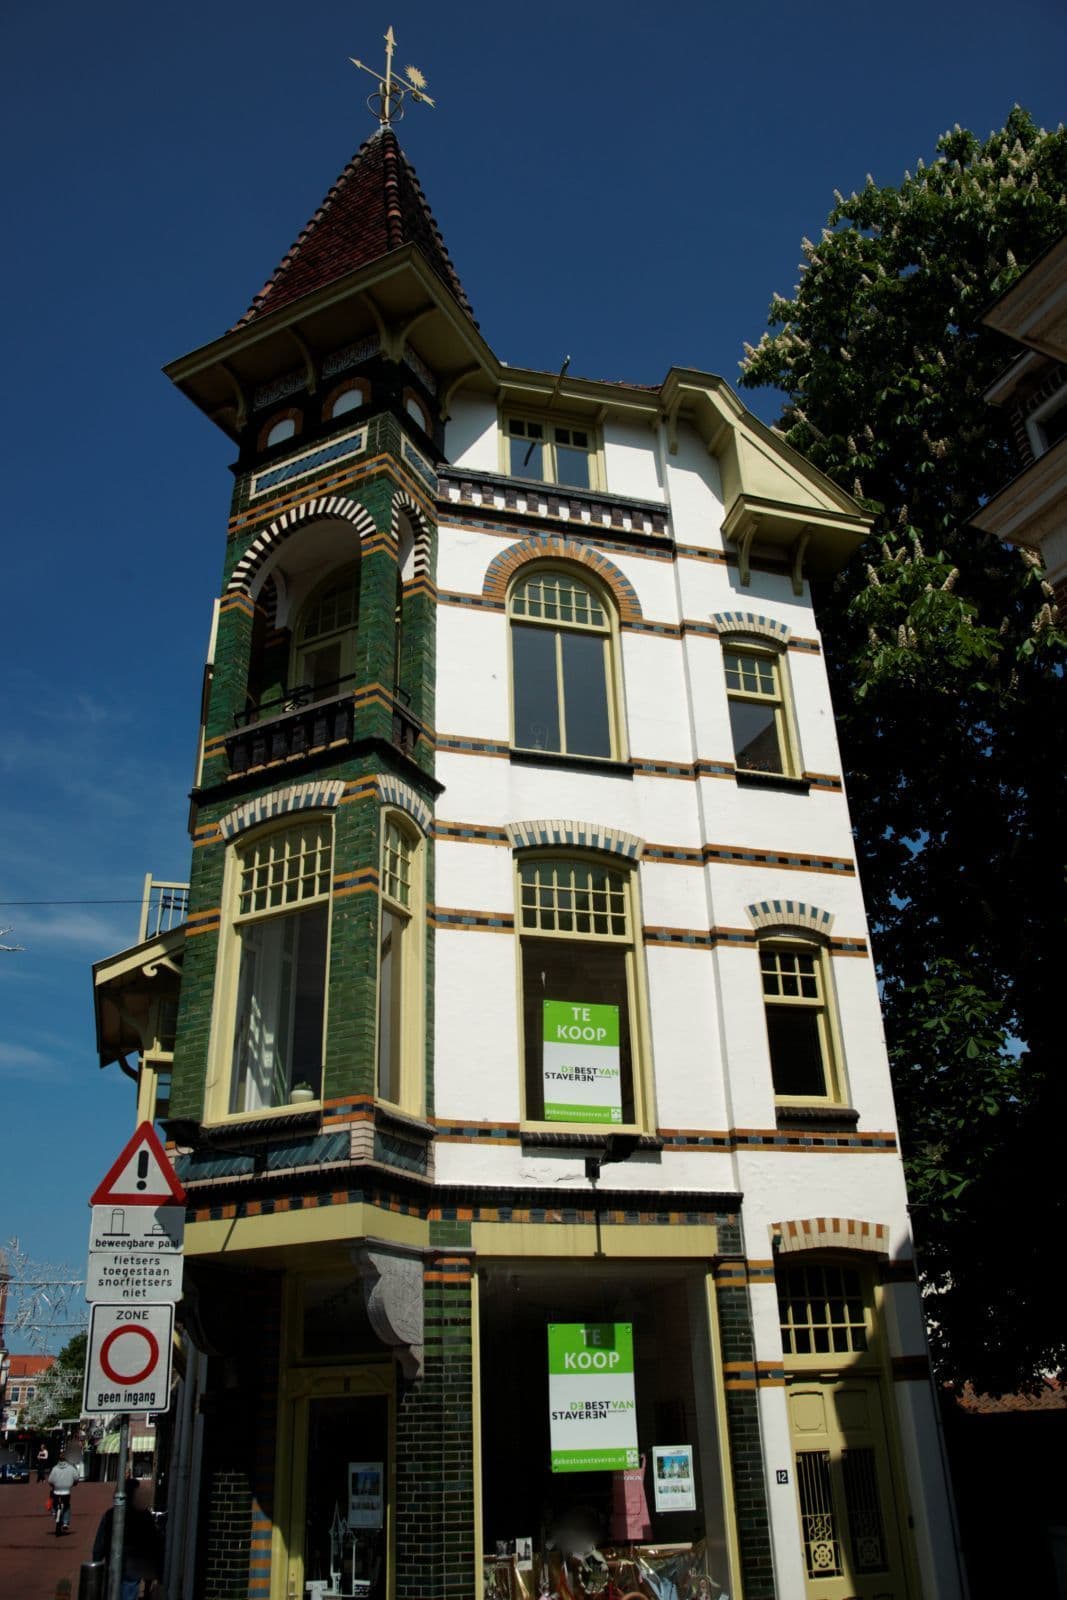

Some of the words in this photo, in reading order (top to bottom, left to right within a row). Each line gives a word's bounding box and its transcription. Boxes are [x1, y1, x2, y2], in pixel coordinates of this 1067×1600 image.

[571, 1007, 591, 1022] TE
[557, 1024, 607, 1041] KOOP
[95, 1239, 154, 1250] beweegbare
[158, 1239, 179, 1250] paal
[114, 1255, 161, 1265] fietsers
[103, 1267, 170, 1277] toegestaan
[98, 1278, 172, 1287] snorfietsers
[122, 1289, 147, 1297] niet
[116, 1310, 149, 1320] ZONE
[580, 1329, 601, 1345] TE
[564, 1351, 620, 1369] KOOP
[97, 1391, 121, 1406] geen
[123, 1389, 156, 1406] ingang
[778, 1471, 787, 1482] 12
